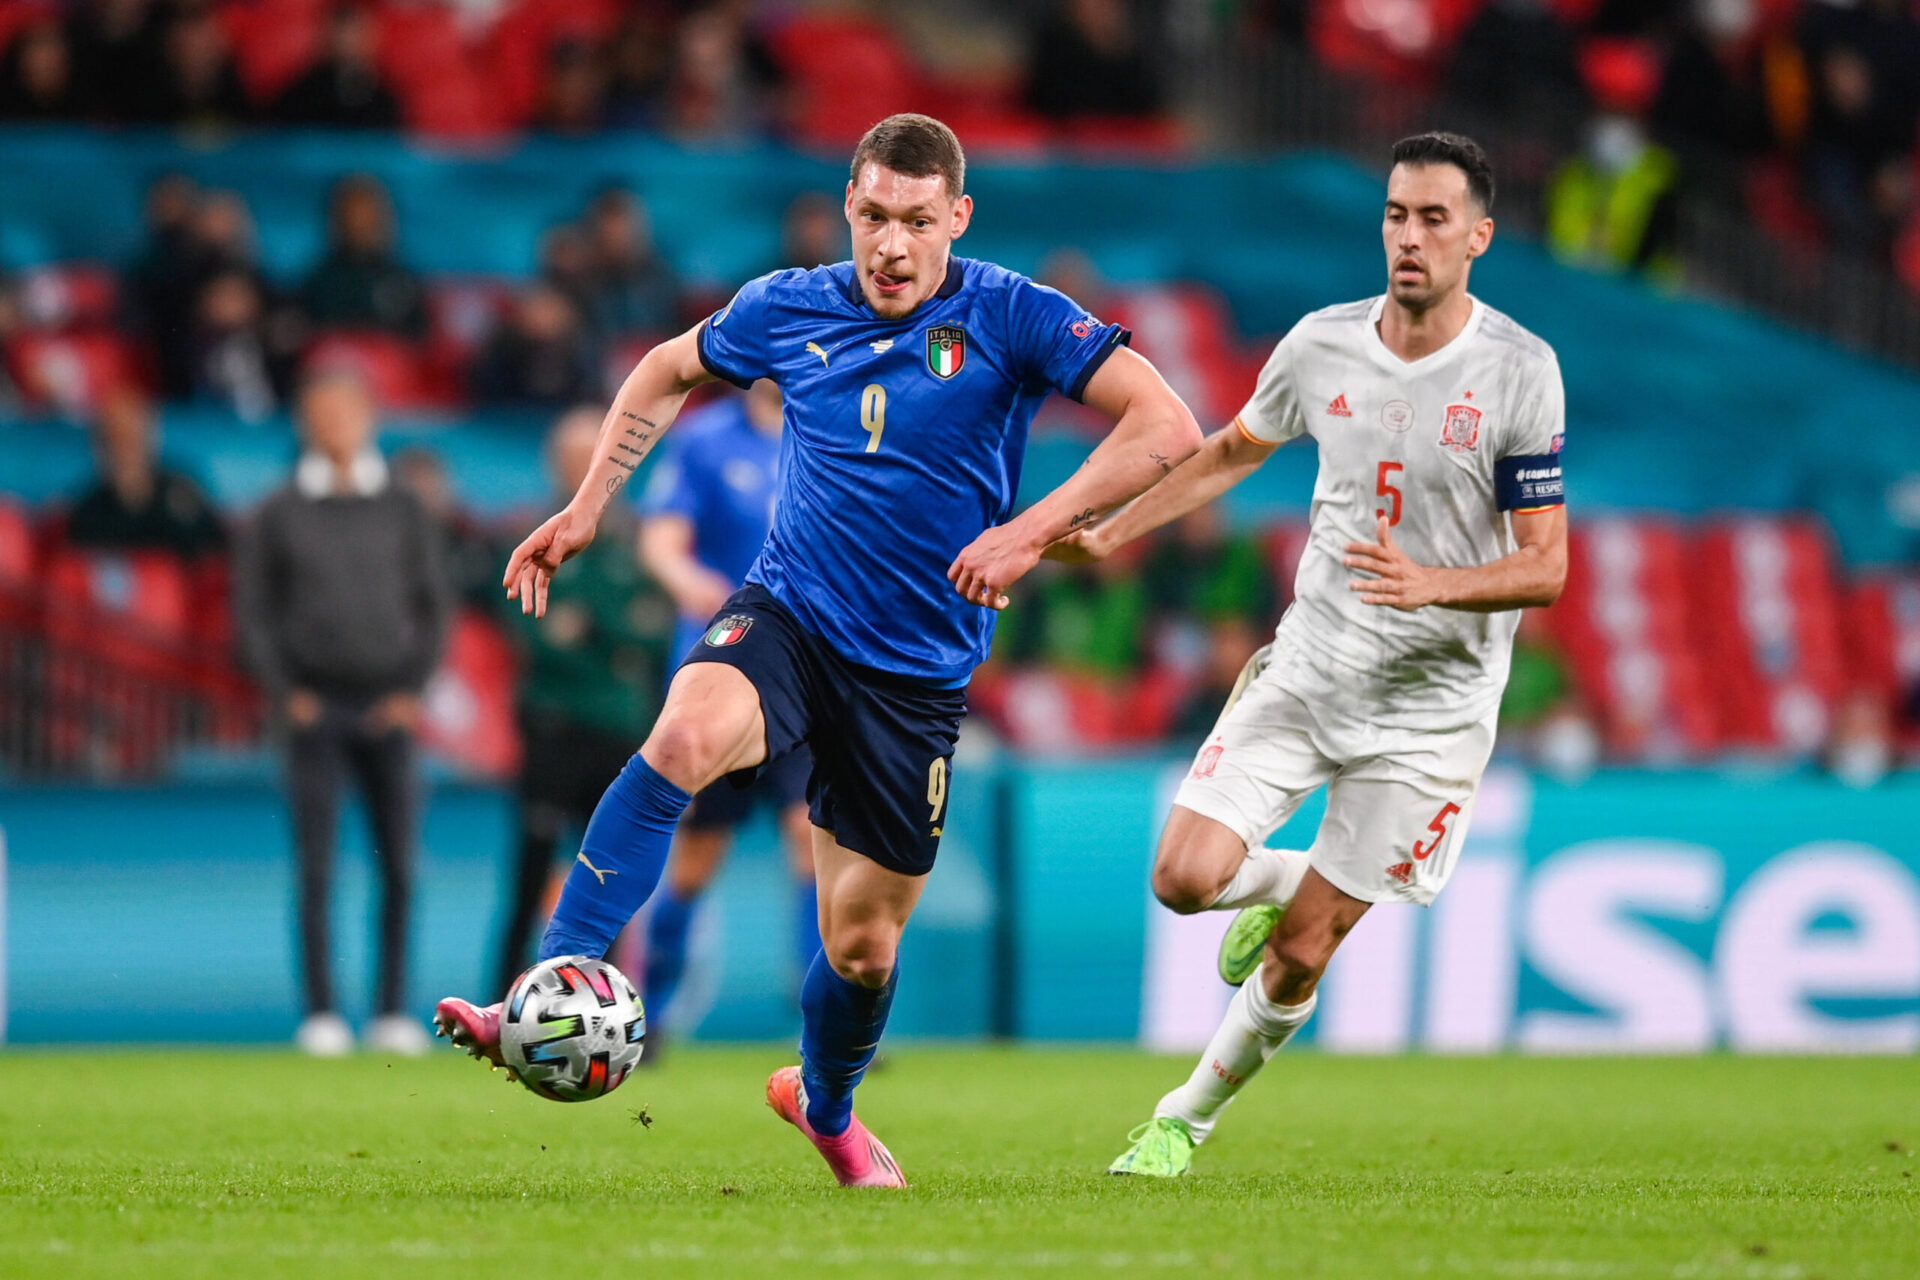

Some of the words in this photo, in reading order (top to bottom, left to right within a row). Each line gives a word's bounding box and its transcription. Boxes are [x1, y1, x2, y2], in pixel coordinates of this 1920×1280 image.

[929, 330, 961, 339] ITALIA
[861, 384, 886, 453] 9
[1376, 461, 1403, 526] 5
[927, 756, 946, 822] 9
[1413, 801, 1461, 860] 5
